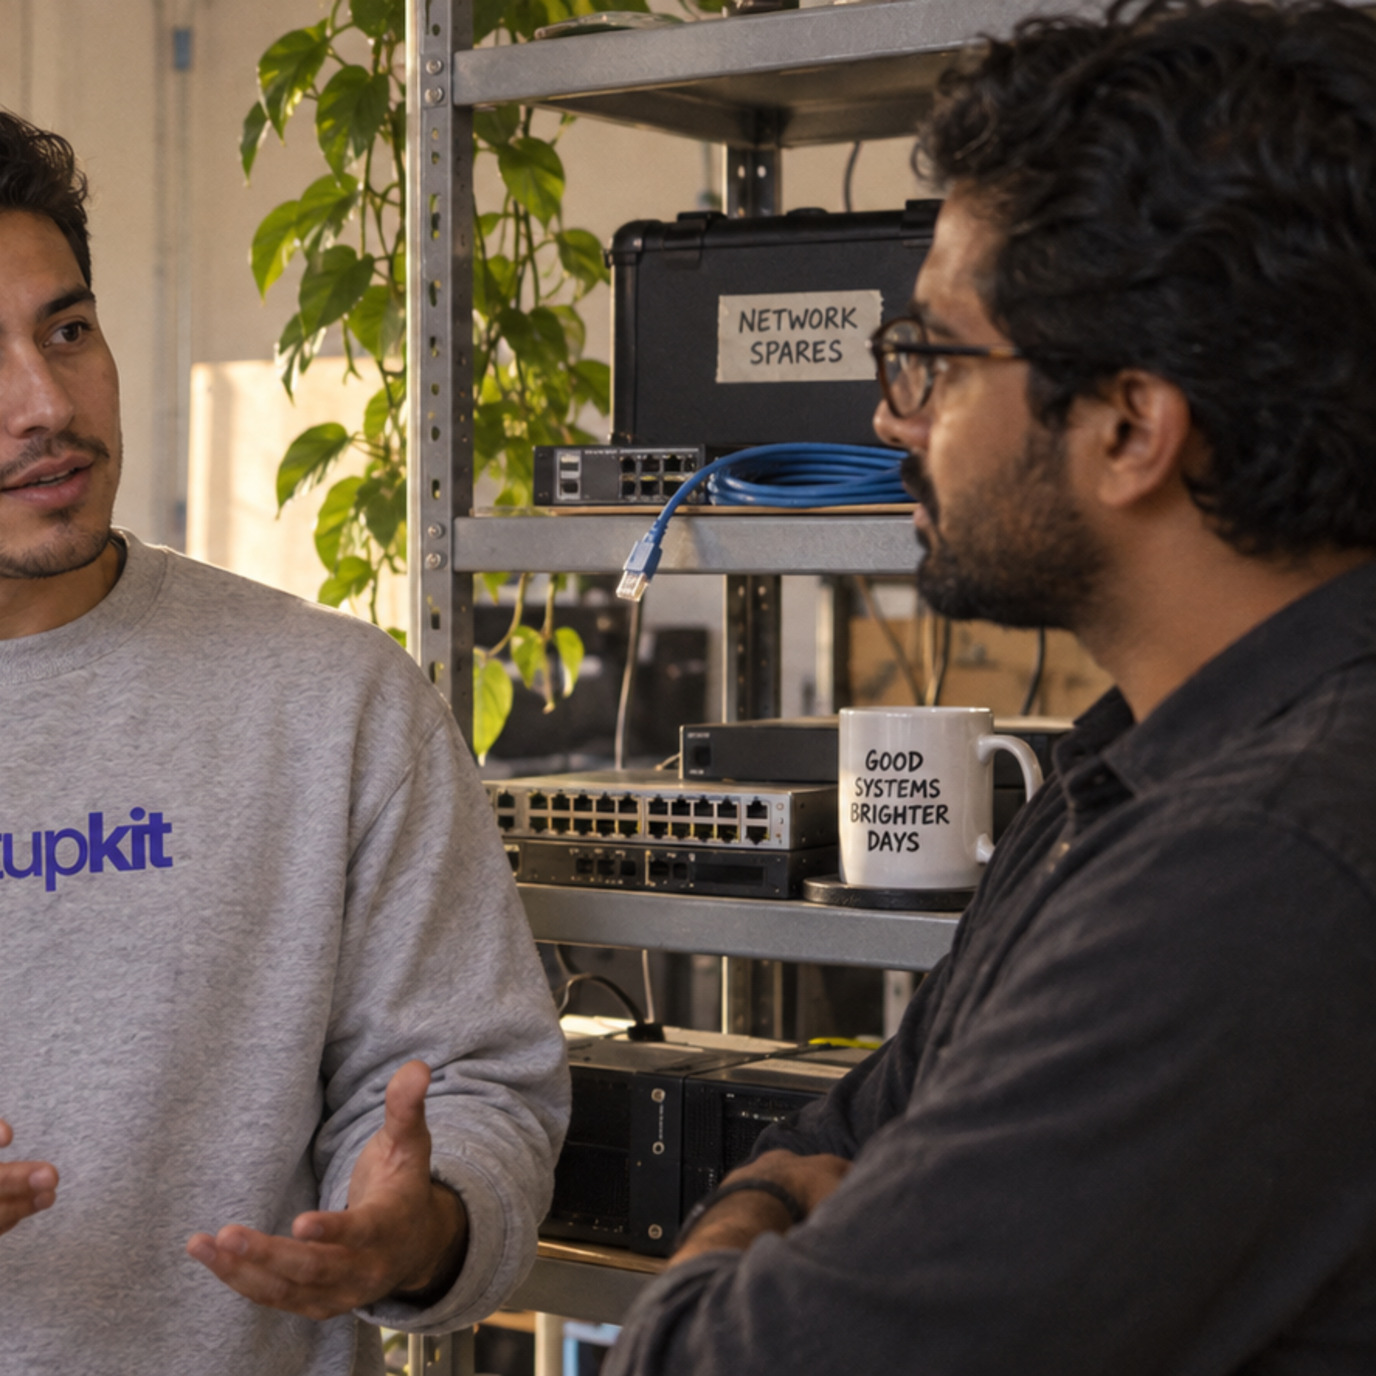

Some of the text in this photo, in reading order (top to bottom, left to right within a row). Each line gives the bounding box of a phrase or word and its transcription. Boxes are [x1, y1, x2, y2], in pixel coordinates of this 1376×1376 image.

[738, 306, 858, 333] NETWORK
[750, 339, 843, 365] SPARES
[865, 749, 924, 772] GOOD
[854, 777, 941, 799] SYSTEMS
[850, 803, 950, 825] BRIGHTER
[867, 830, 920, 853] DAYS
